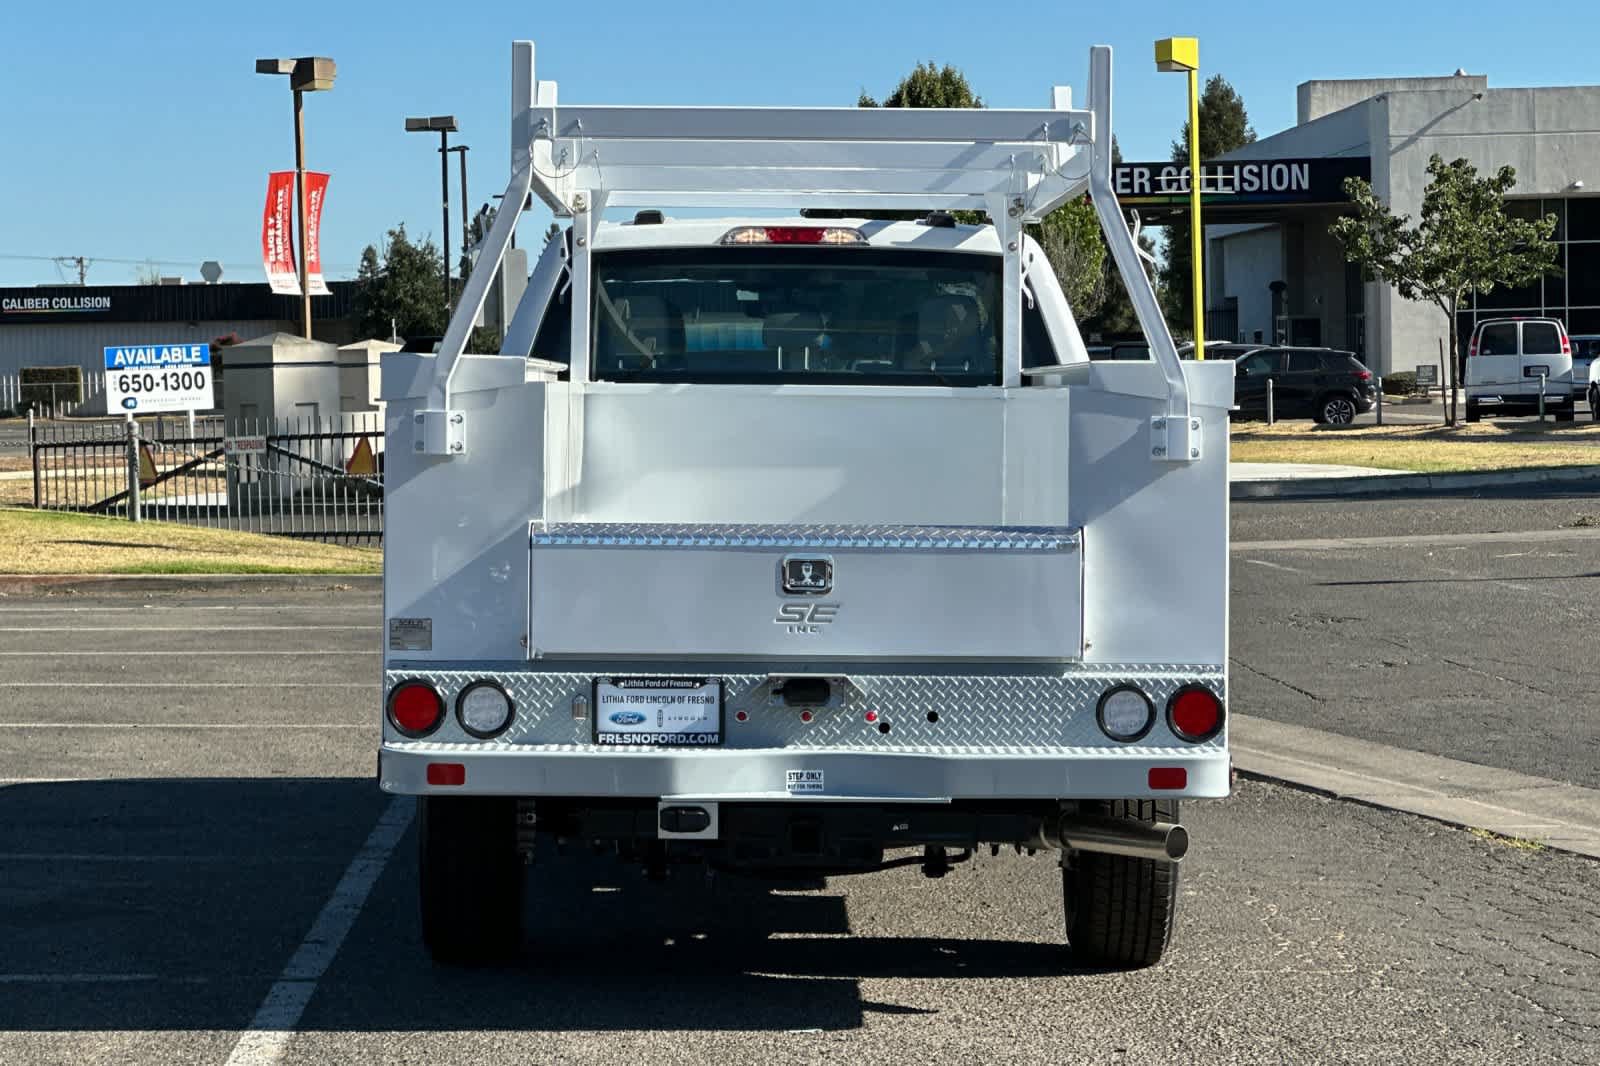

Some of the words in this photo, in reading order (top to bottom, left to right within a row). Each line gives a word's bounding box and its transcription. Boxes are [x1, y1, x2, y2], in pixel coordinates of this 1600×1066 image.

[2, 298, 49, 310] CALIBER
[52, 296, 110, 309] COLLISION
[114, 346, 202, 366] AVAILABLE
[670, 680, 692, 688] Fresno
[602, 695, 624, 704] LITHIA
[626, 695, 643, 704] FORD
[646, 695, 675, 704] LINCOLN
[676, 695, 685, 704] OF
[687, 695, 715, 704] FRESNO
[617, 713, 640, 724] Ford
[598, 733, 719, 744] FRESNOFORD.COM
[788, 771, 804, 780] STEP
[806, 771, 821, 780] ONLY
